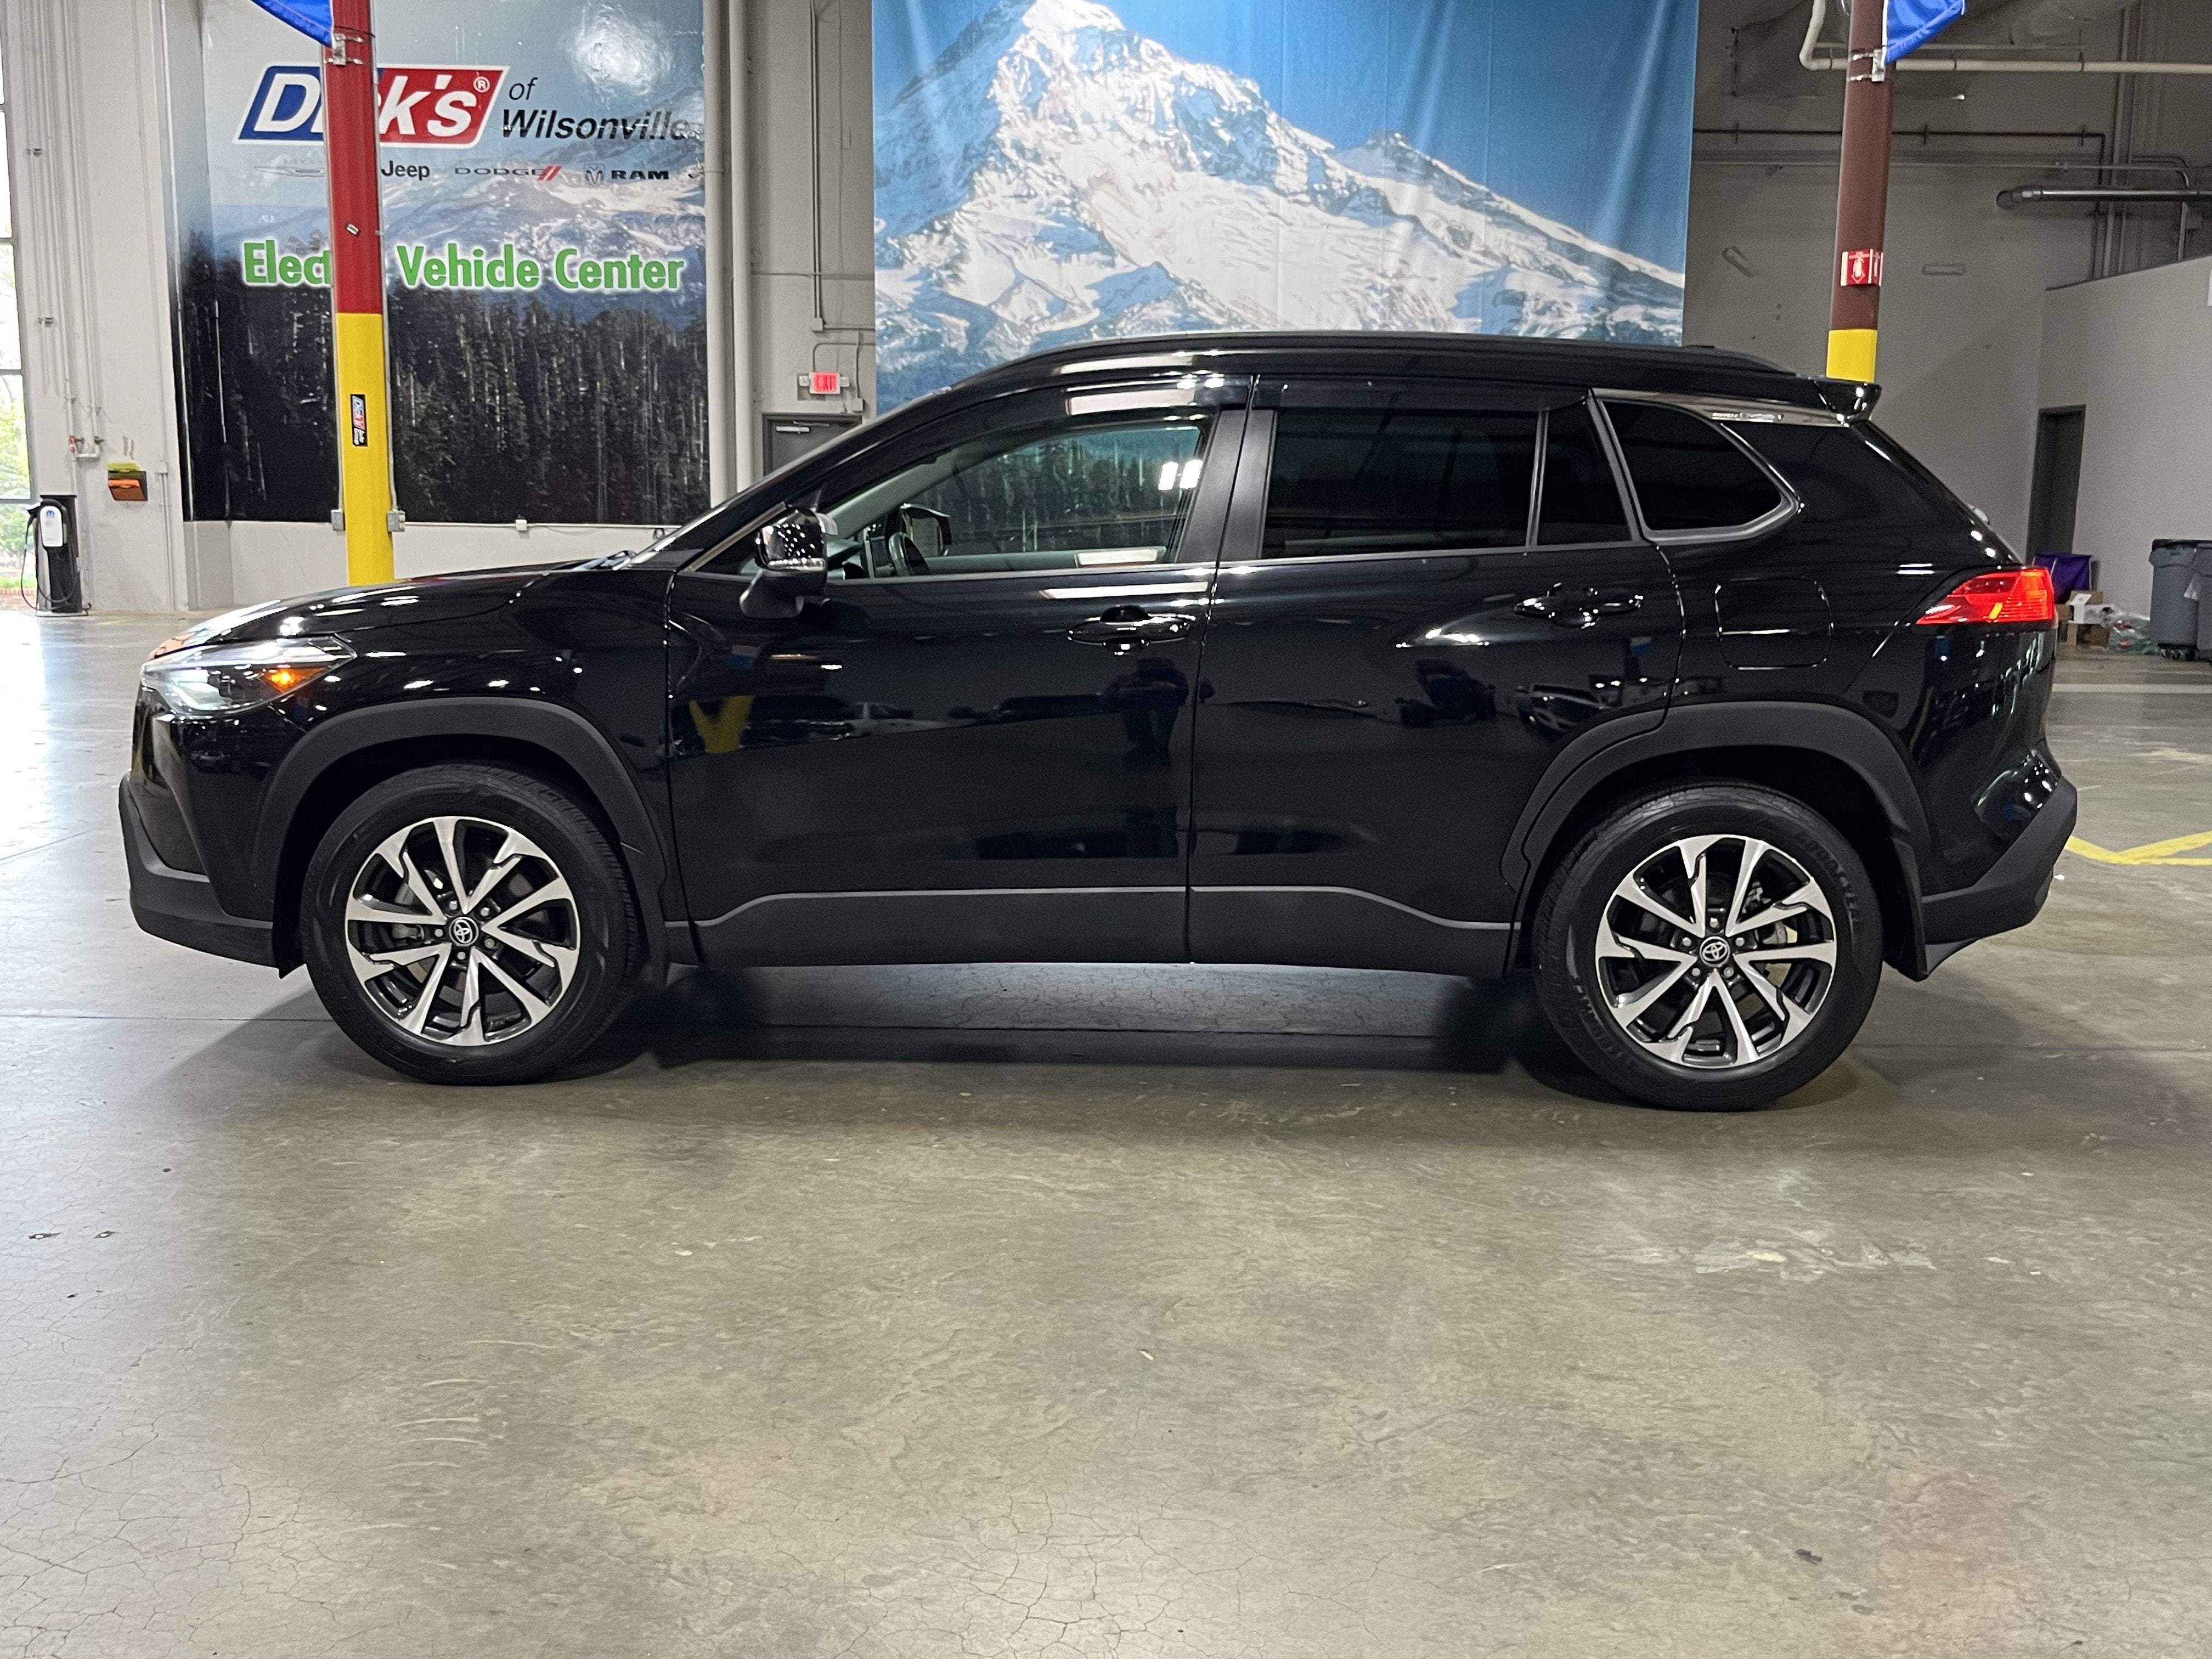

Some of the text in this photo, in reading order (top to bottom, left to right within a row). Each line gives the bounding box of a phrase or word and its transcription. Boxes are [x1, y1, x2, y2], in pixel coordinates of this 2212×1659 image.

[253, 73, 538, 137] Dk's of
[502, 109, 690, 140] Wilsonville
[381, 160, 431, 181] Jeep
[455, 167, 546, 176] DODGE
[611, 170, 669, 180] RAM
[244, 239, 685, 289] Elect Vehicle Center
